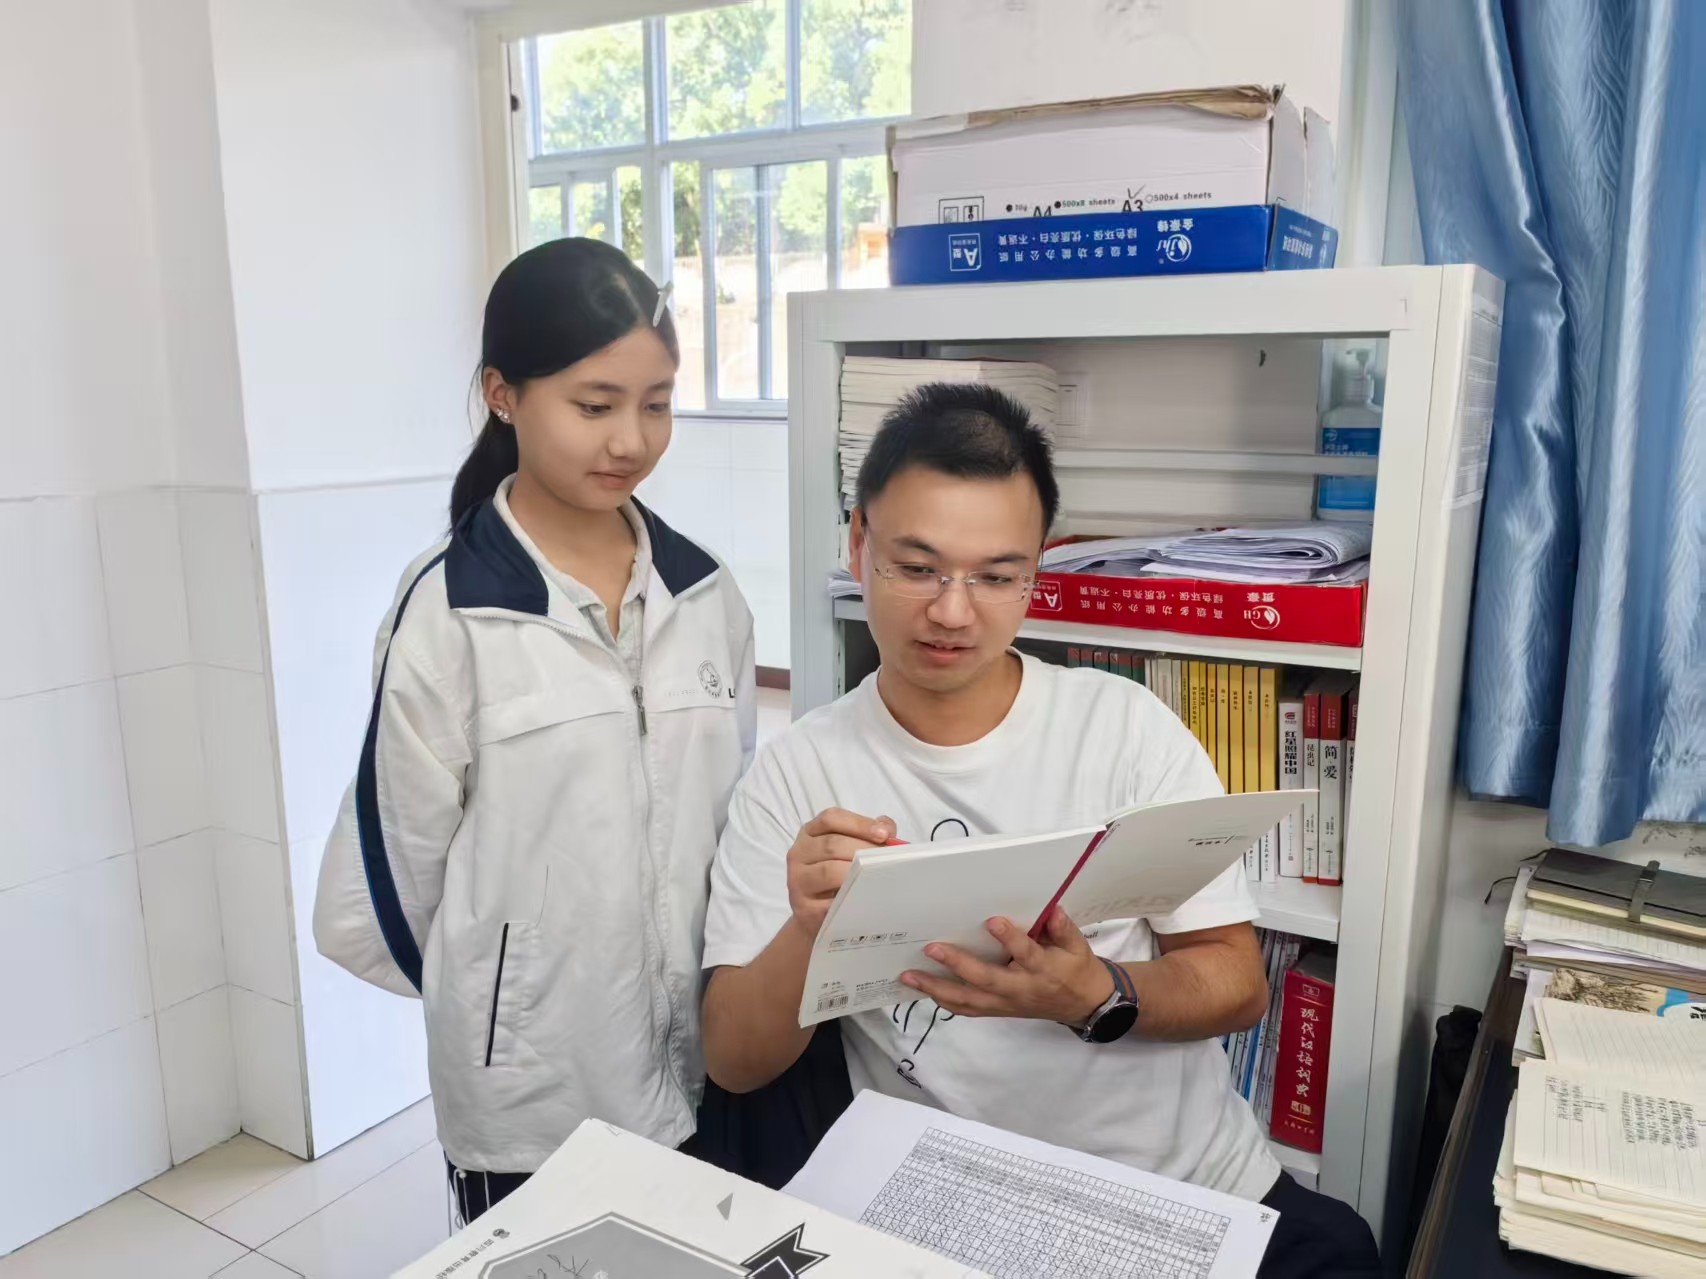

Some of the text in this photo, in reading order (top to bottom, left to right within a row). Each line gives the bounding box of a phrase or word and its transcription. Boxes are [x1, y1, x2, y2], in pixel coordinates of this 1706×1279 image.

[1089, 198, 1116, 207] sheets
[1183, 191, 1212, 200] sheets
[1122, 199, 1144, 213] A3
[998, 245, 1137, 262] 高级多功能办公用纸
[1079, 600, 1224, 619] 高级多功能办公用纸
[1243, 610, 1261, 620] GH
[1284, 730, 1298, 775] 红星照耀中国
[1306, 743, 1316, 767] 昆虫记
[1295, 1007, 1320, 1098] 现代汉语词典
